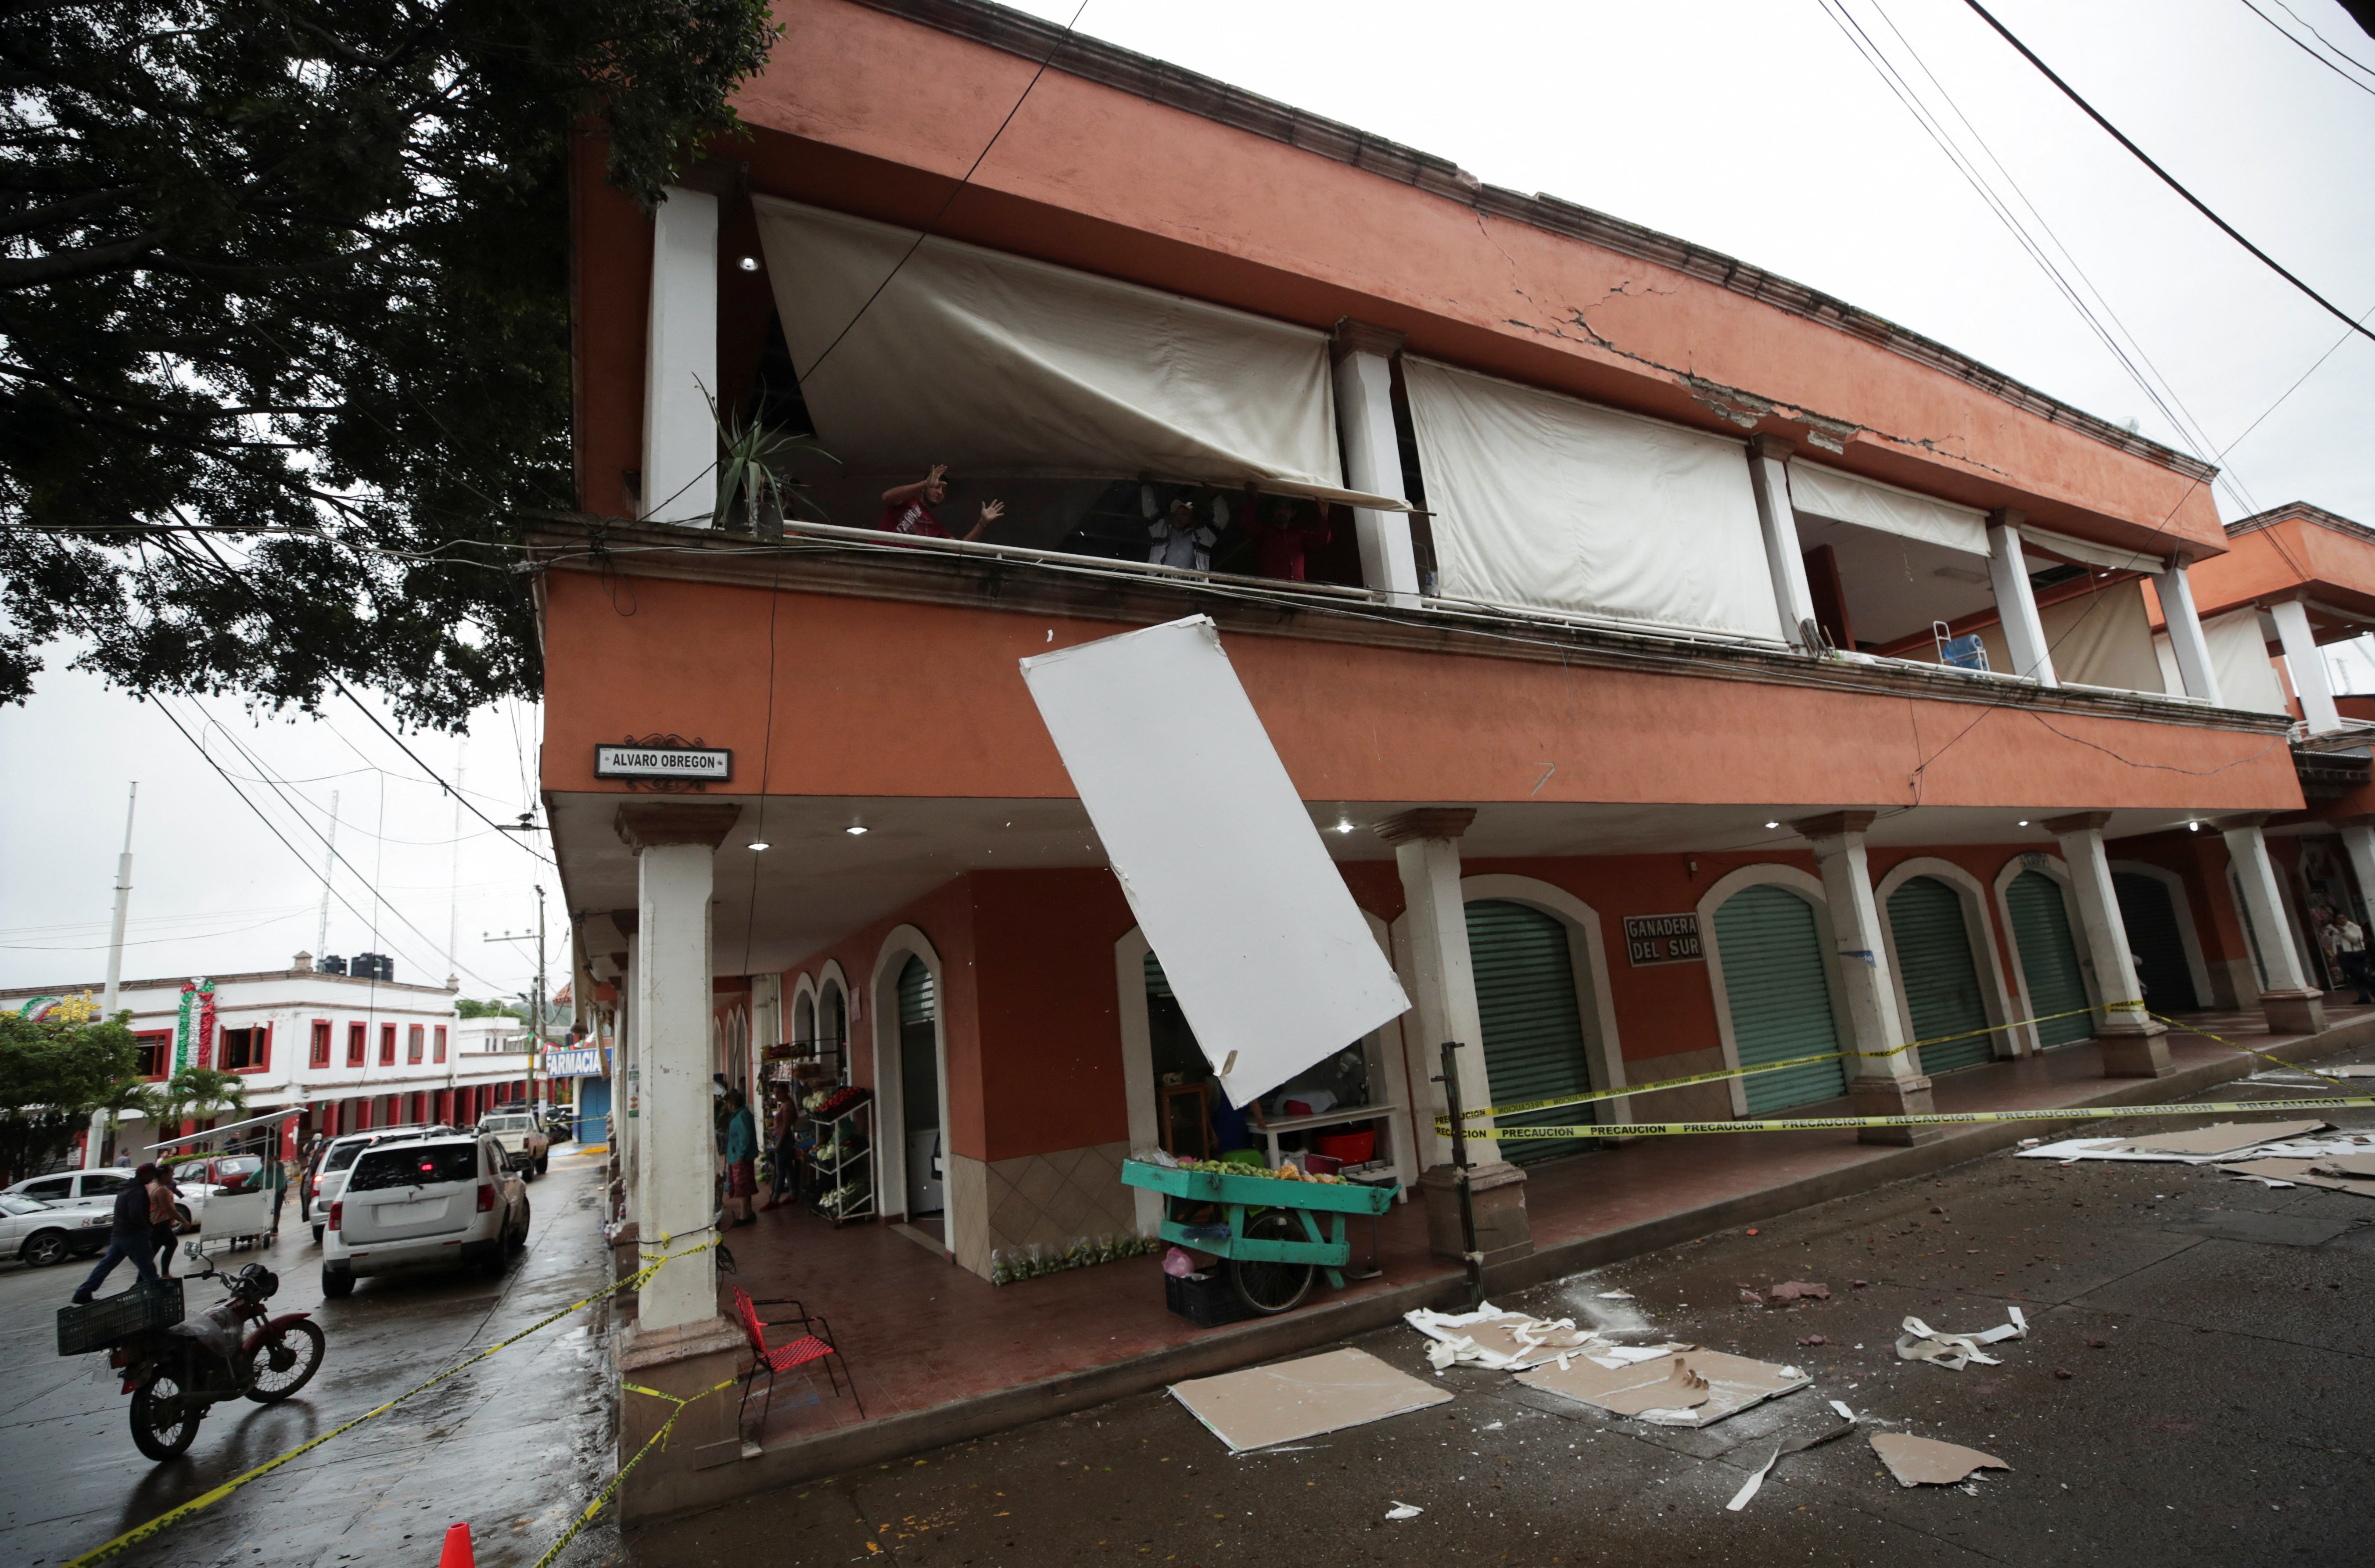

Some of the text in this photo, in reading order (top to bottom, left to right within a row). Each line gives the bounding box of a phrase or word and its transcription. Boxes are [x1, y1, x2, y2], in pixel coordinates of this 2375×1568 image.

[613, 754, 714, 768] ALVARO OBREGON
[1629, 917, 1697, 937] GANADERA
[1633, 938, 1699, 959] DEL SUR
[546, 1051, 601, 1075] FARMACIA
[1503, 1127, 1574, 1137] PRECAUCIÓN
[2236, 1099, 2348, 1110] PRECAUCIÓN
[82, 1218, 90, 1227] 8
